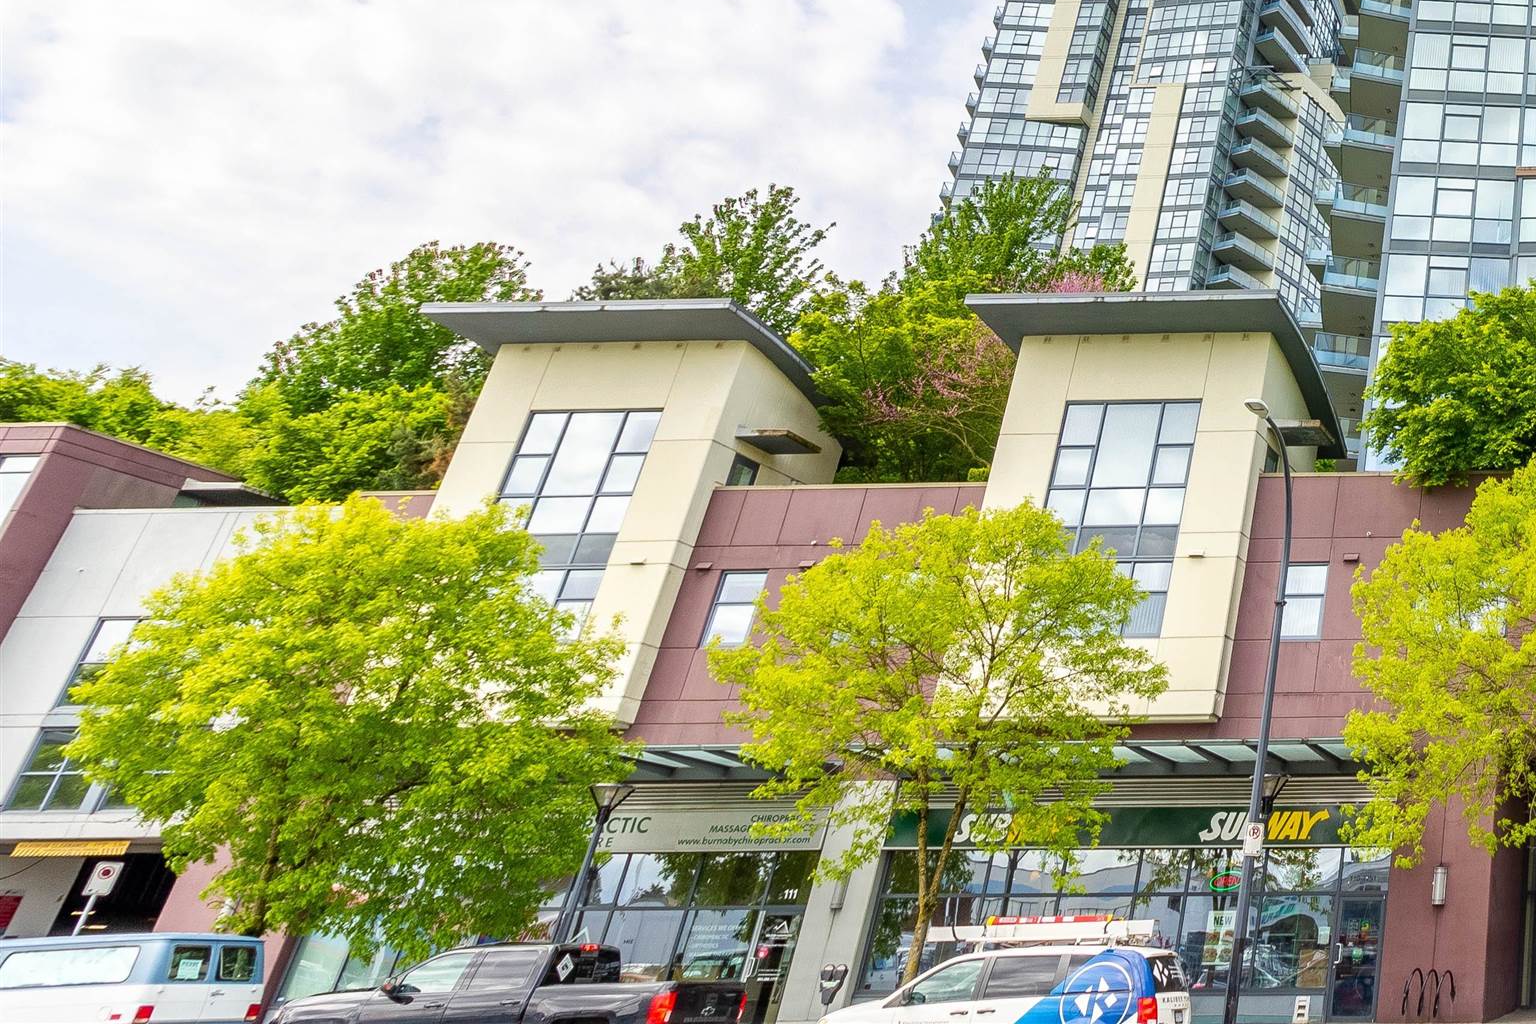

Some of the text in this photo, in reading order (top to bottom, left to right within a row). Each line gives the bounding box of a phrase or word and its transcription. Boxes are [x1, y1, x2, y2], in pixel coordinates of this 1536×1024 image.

[1198, 808, 1330, 843] SUWAY
[783, 888, 799, 900] 111
[1213, 915, 1233, 926] NEW
